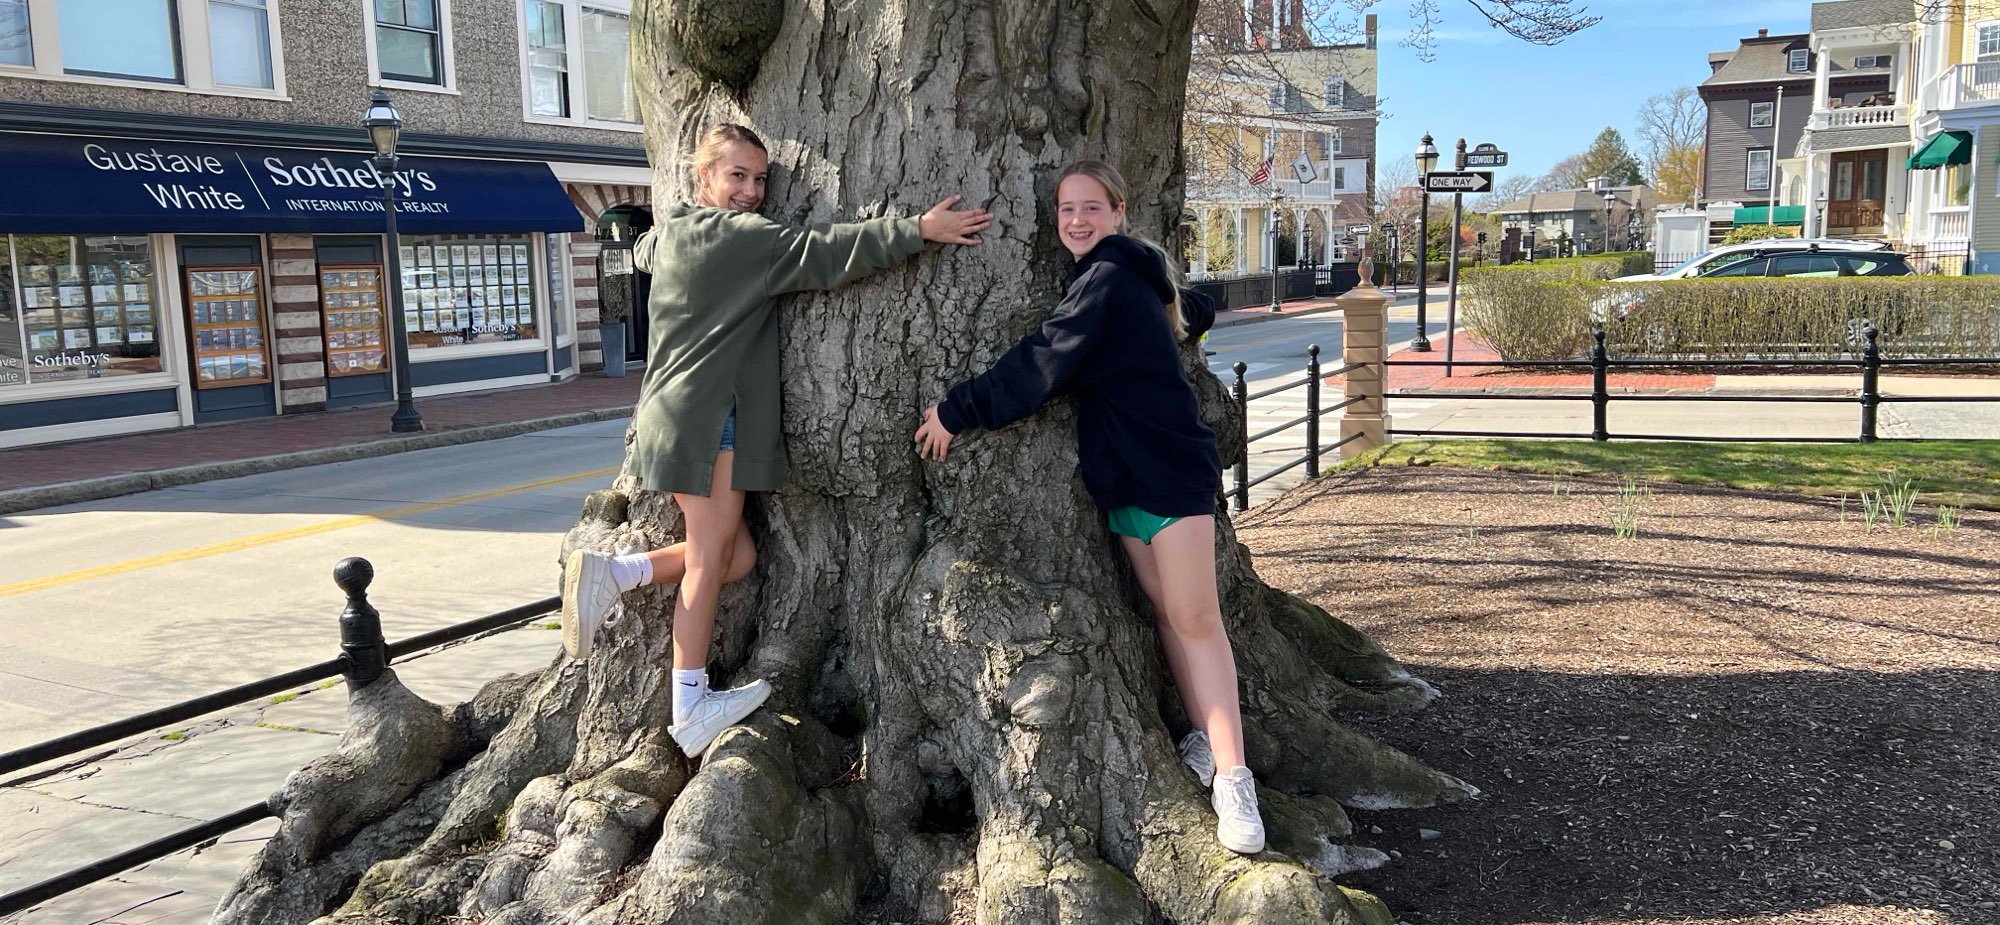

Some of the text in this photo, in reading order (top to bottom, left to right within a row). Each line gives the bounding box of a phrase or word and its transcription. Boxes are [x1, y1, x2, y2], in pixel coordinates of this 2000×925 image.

[83, 143, 225, 175] Gustave
[1467, 154, 1505, 165] REDWOOD ST
[263, 156, 437, 198] Sotheby's
[1432, 178, 1472, 187] ONE WAY
[143, 183, 245, 210] White
[285, 199, 450, 213] INTERNATIONL REALTY
[33, 350, 111, 368] Sotheby's
